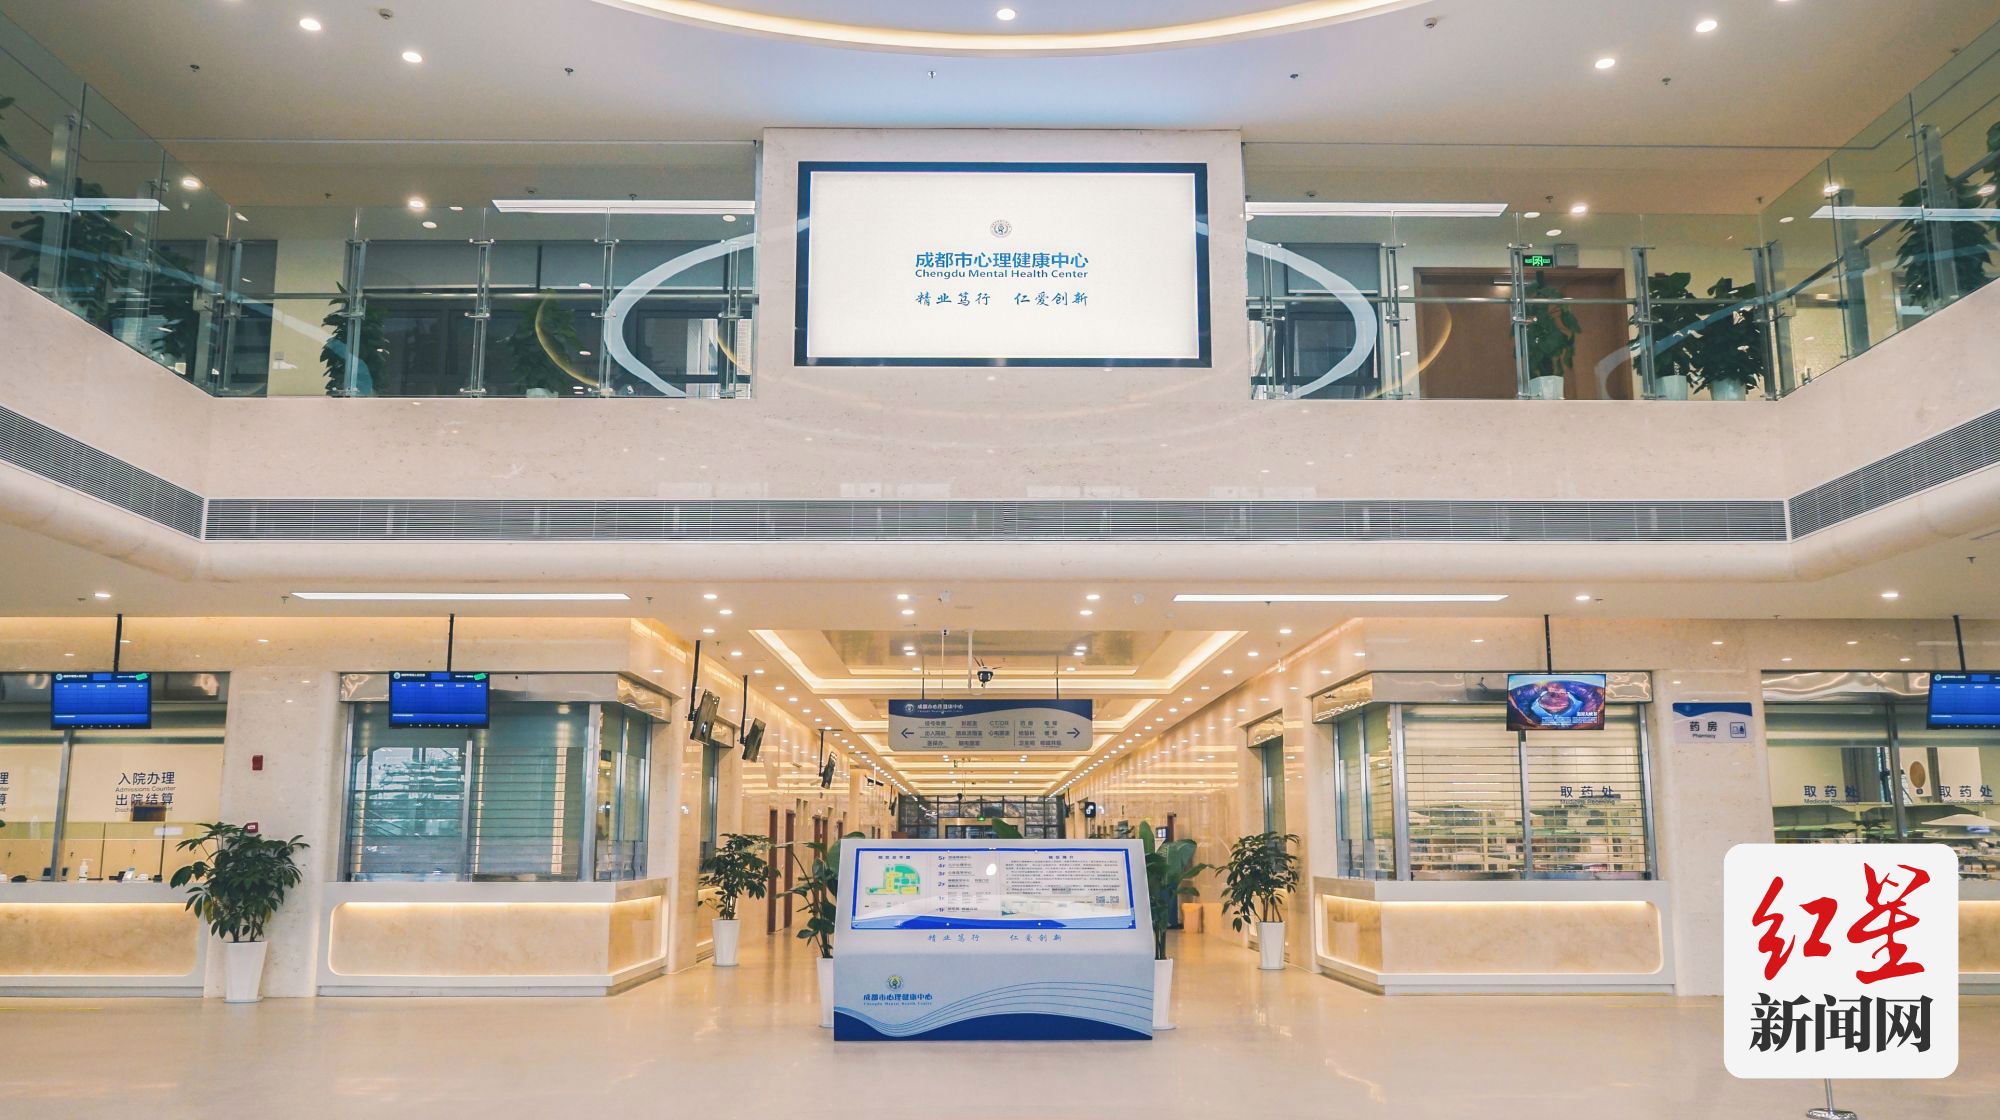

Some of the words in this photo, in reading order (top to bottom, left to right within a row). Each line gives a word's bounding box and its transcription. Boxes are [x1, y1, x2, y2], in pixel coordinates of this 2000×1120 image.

[915, 252, 1089, 268] 成都市心理健康中心
[915, 270, 966, 280] Chengdu
[968, 270, 1008, 278] Mental
[1011, 270, 1048, 278] Health
[1051, 270, 1089, 278] Center
[1013, 291, 1089, 307] 仁爱创新
[1689, 721, 1718, 732] 药房
[118, 771, 175, 785] 入院办理
[1560, 785, 1615, 798] 取药处
[1804, 785, 1860, 798] 取药处
[1938, 784, 1993, 798] 取药处
[115, 792, 174, 806] 出院结算
